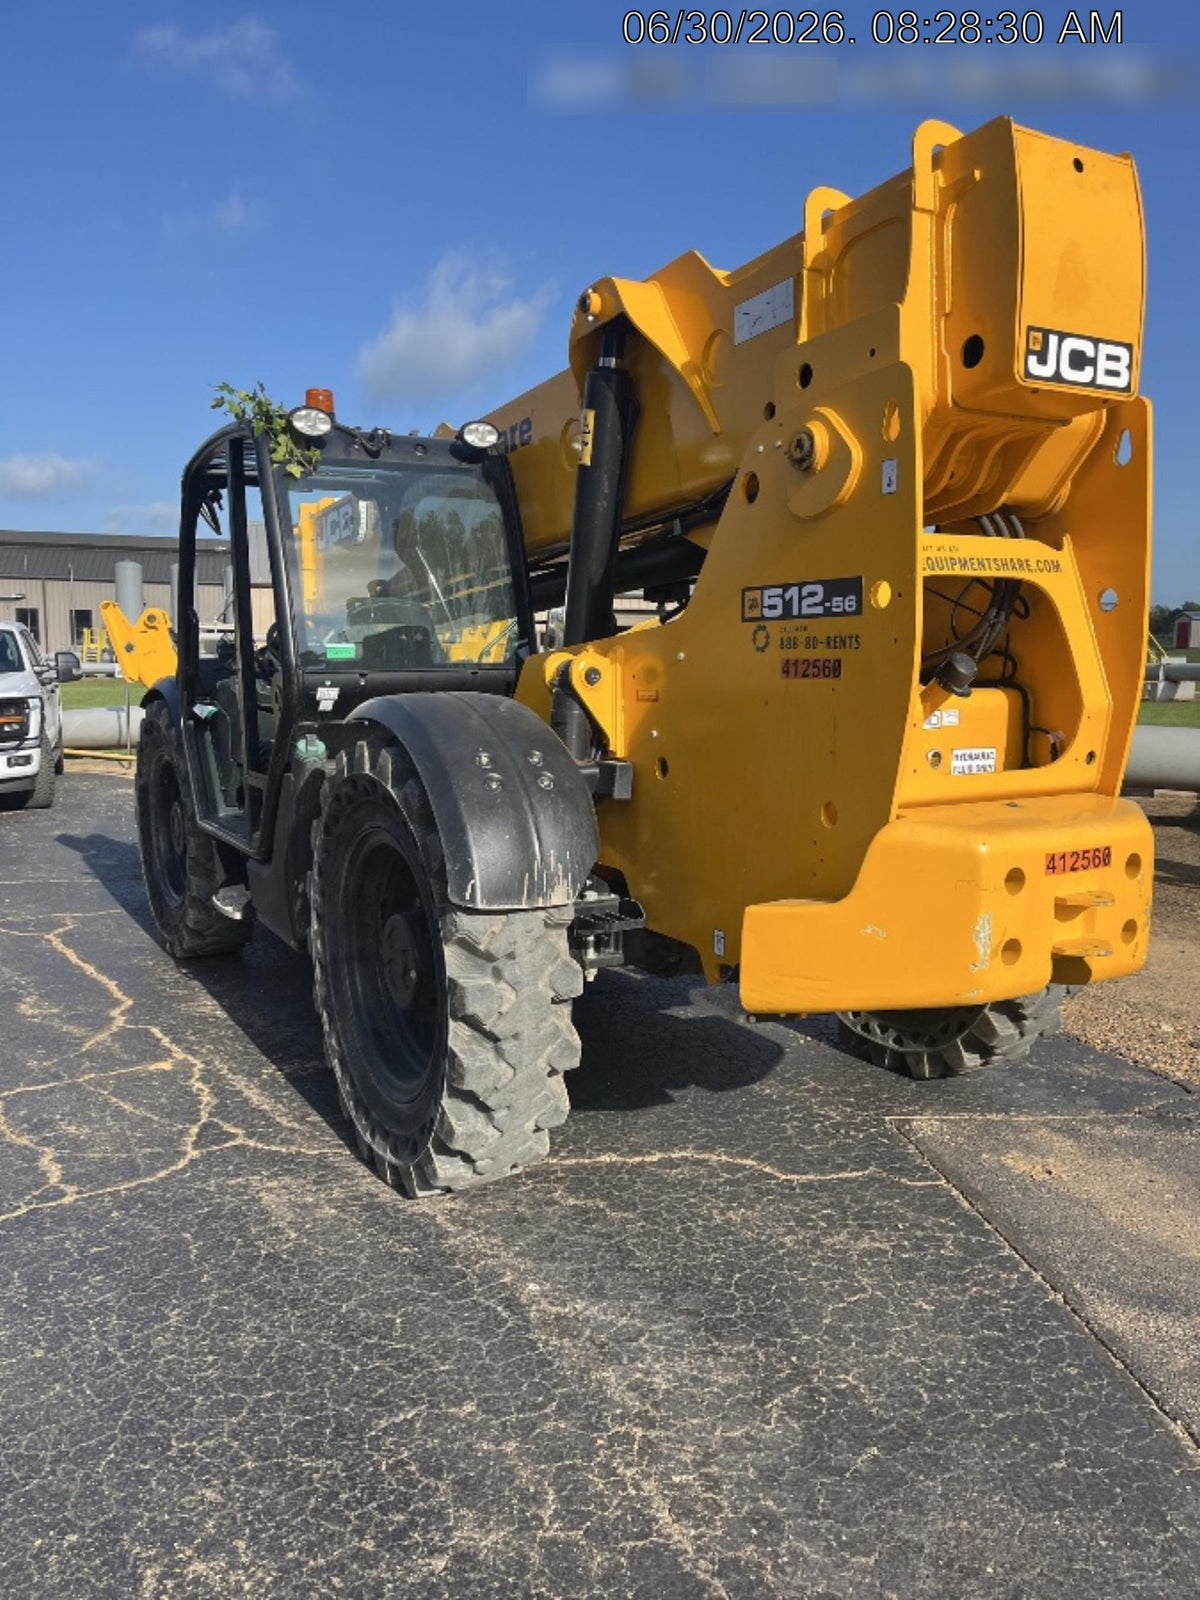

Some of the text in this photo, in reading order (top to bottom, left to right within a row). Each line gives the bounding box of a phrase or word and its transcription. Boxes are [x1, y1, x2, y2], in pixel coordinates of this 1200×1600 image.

[1027, 333, 1130, 388] JCB
[762, 584, 857, 617] 512-56
[782, 658, 842, 678] 412560
[1046, 846, 1112, 873] 412560
